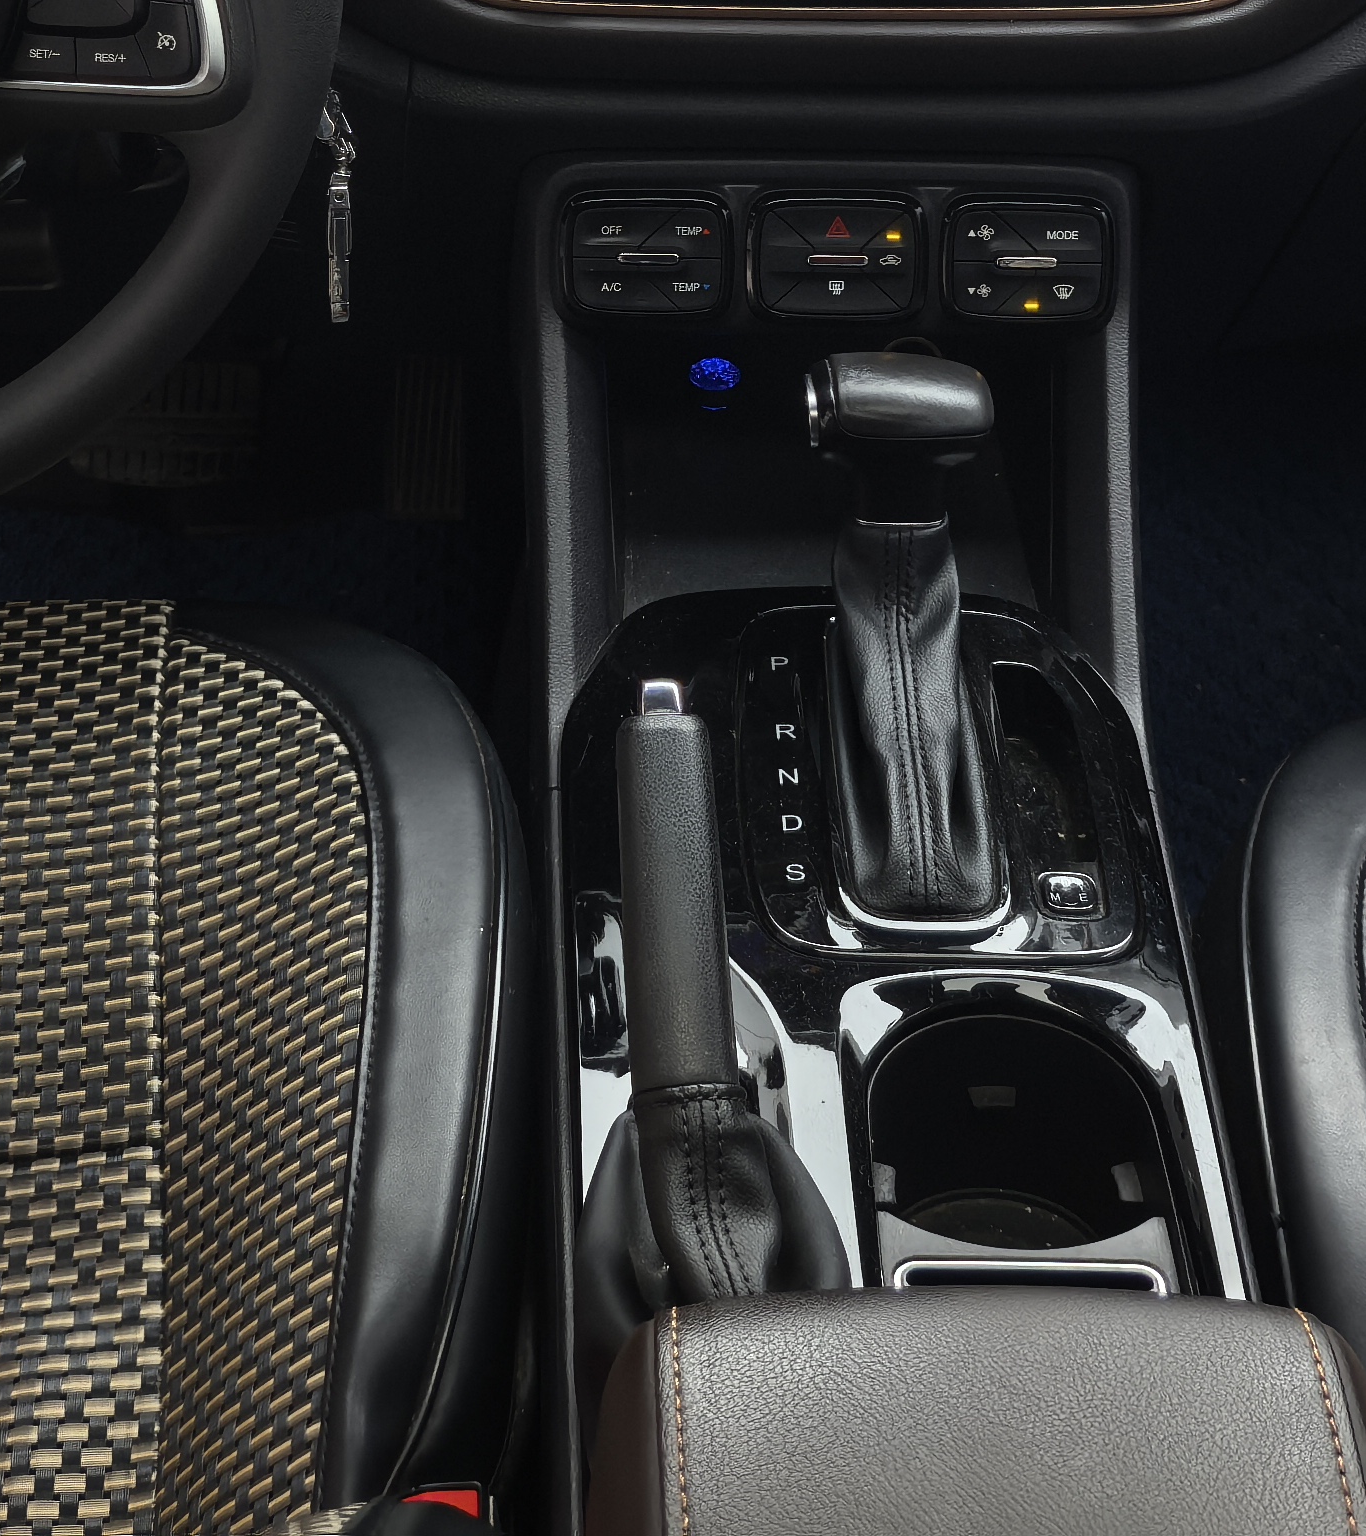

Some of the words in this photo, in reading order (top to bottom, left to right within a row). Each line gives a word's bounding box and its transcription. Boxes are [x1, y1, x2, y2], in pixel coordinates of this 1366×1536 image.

[94, 52, 127, 63] RES/+
[601, 225, 623, 235] OFF
[675, 226, 703, 236] TEMP
[1046, 230, 1079, 240] MODE
[601, 282, 622, 292] A/C
[672, 282, 701, 292] TEMP
[770, 656, 789, 671] P
[775, 723, 797, 741] R
[778, 767, 799, 786] N
[781, 814, 803, 832] D
[785, 863, 806, 881] S
